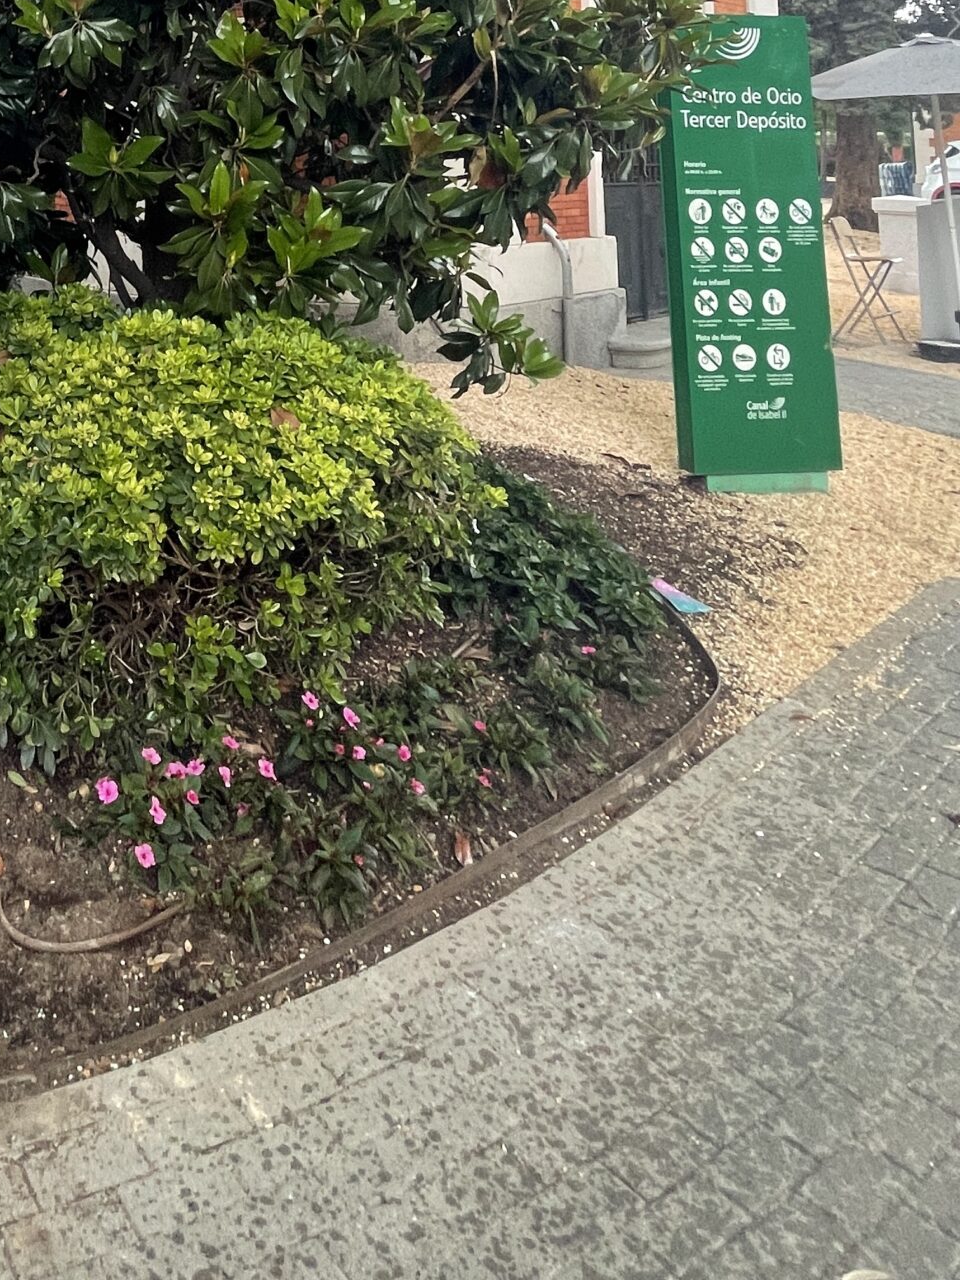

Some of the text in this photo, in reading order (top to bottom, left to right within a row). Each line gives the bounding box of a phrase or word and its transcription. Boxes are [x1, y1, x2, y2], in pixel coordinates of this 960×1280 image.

[682, 86, 802, 104] Centro de Ocio
[680, 110, 806, 132] Tercer Depósito
[692, 277, 708, 286] Área
[746, 400, 768, 410] Canal
[747, 410, 787, 420] de Isabel II
